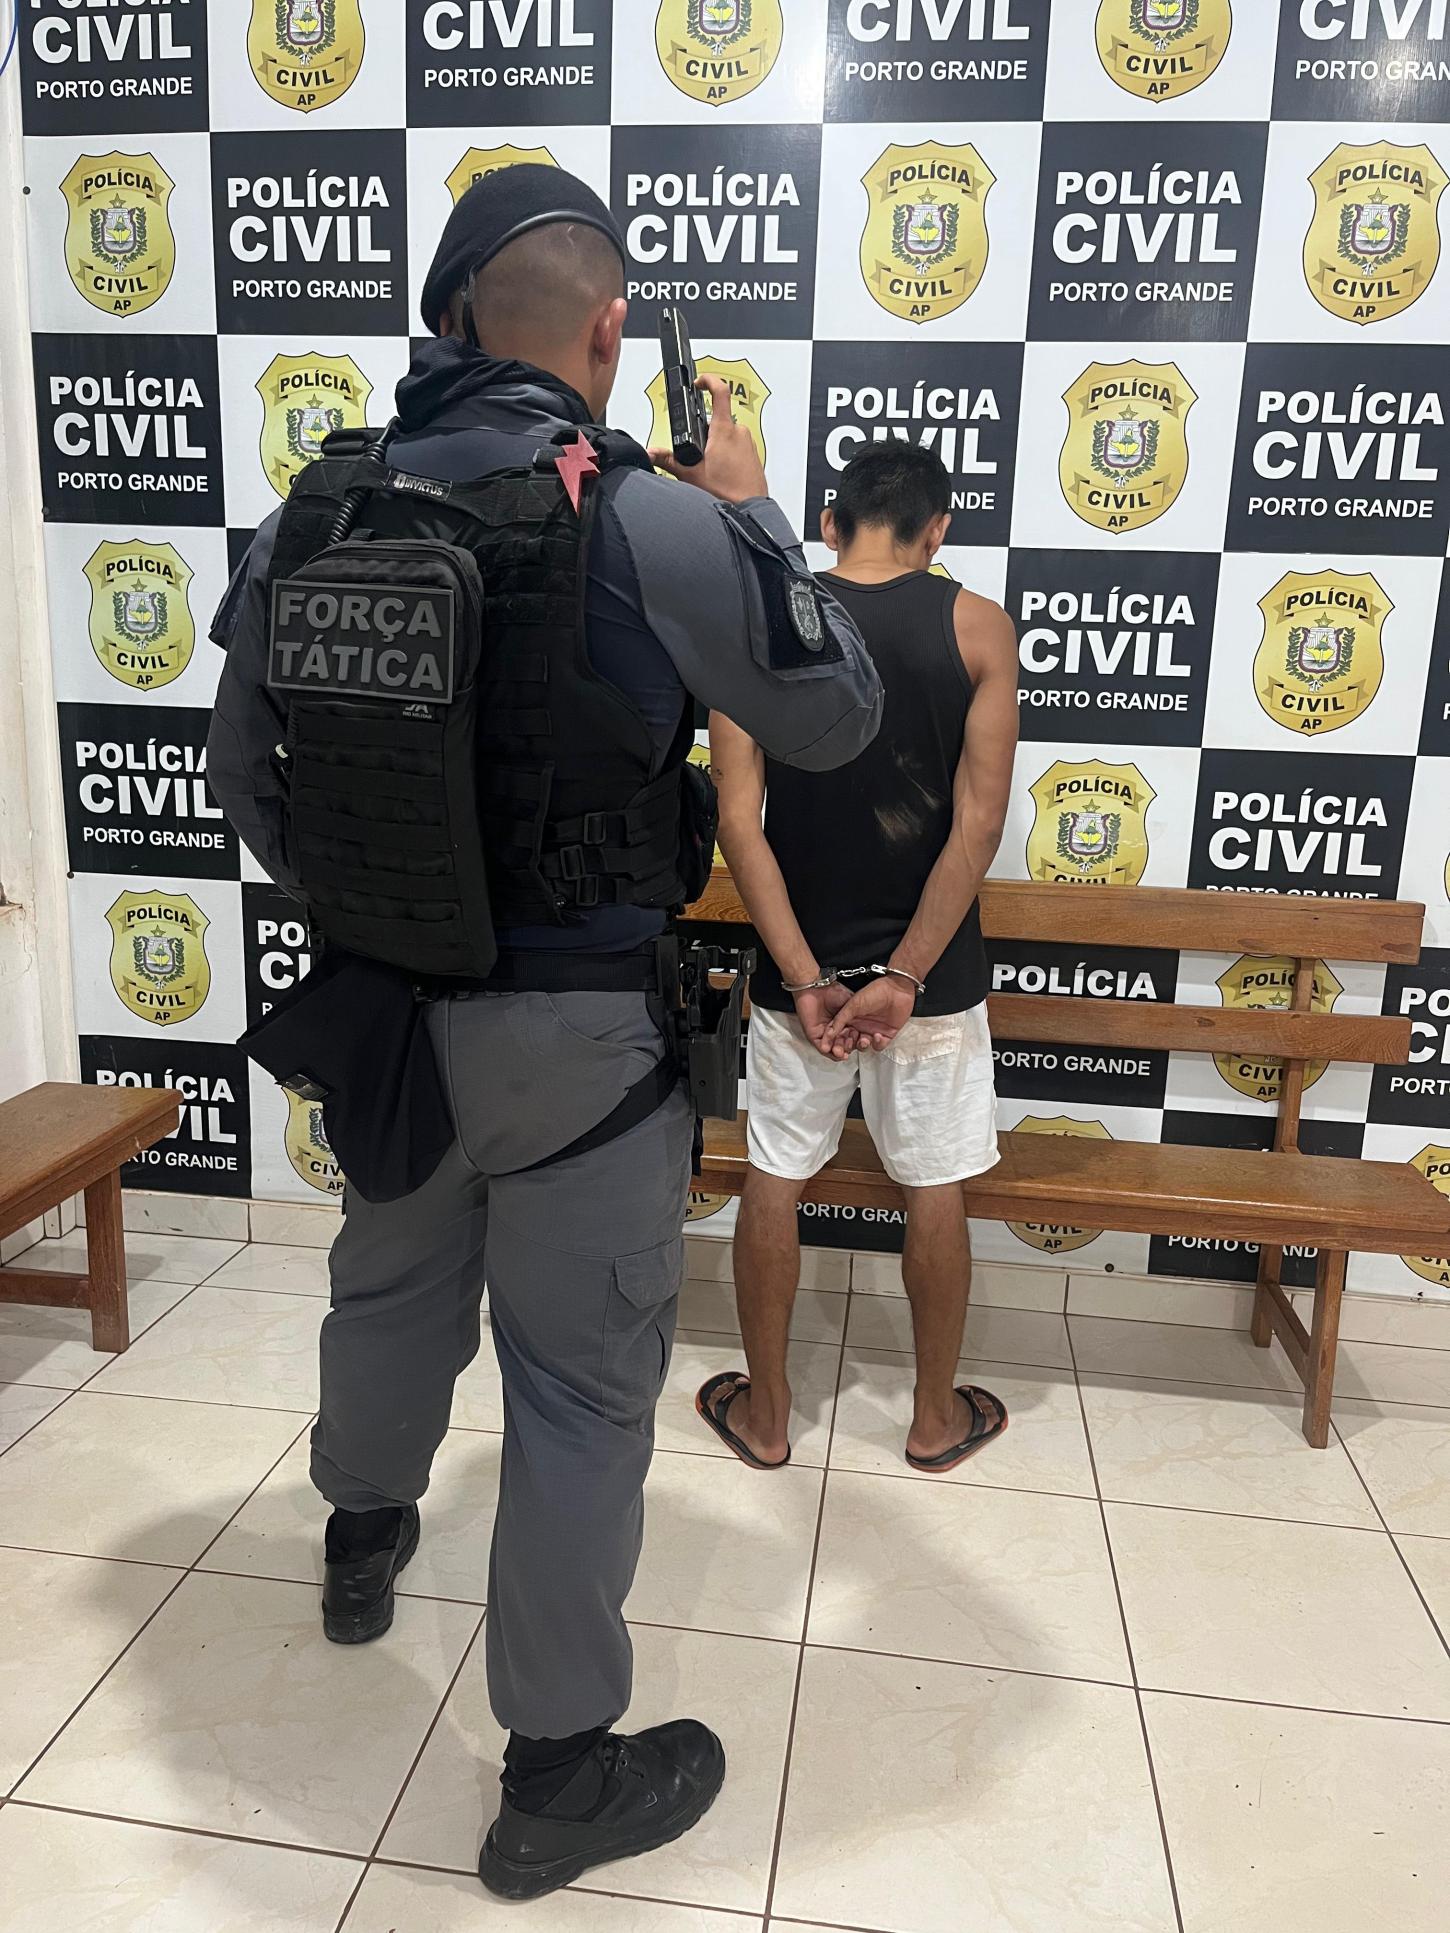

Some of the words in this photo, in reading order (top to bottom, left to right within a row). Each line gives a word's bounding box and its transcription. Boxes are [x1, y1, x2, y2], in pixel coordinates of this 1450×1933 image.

[423, 0, 593, 50] CIVIL
[847, 0, 1029, 42] CIVIL
[1299, 0, 1450, 40] CIVI
[33, 13, 191, 63] CIVIL
[686, 60, 748, 78] CIVIL
[845, 61, 924, 81] PORTO
[931, 61, 1027, 80] GRANDE
[1127, 56, 1193, 74] CIVIL
[1295, 60, 1379, 80] PORTO
[1385, 61, 1450, 81] GRAN
[277, 70, 334, 87] CIVIL
[425, 68, 497, 87] PORTO
[504, 66, 593, 86] GRANDE
[37, 80, 104, 98] PORTO
[110, 77, 192, 96] GRANDE
[707, 87, 727, 98] AP
[1147, 83, 1169, 94] AP
[297, 94, 315, 105] AP
[83, 168, 154, 193] POLÍCIA
[890, 160, 970, 186] POLÍCIA
[1339, 160, 1423, 187] POLÍCIA
[228, 169, 389, 208] POLÍCIA
[628, 166, 800, 206] POLÍCIA
[1056, 163, 1241, 204] POLÍCIA
[230, 216, 390, 262] CIVIL
[627, 215, 798, 263] CIVIL
[1053, 213, 1236, 263] CIVIL
[94, 276, 148, 293] CIVIL
[233, 280, 301, 297] PORTO
[307, 280, 392, 298] GRANDE
[628, 282, 699, 300] PORTO
[707, 282, 797, 300] GRANDE
[890, 279, 952, 297] CIVIL
[1050, 283, 1128, 301] PORTO
[1135, 283, 1233, 301] GRANDE
[1333, 279, 1400, 298] CIVIL
[114, 300, 131, 310] AP
[910, 305, 930, 316] AP
[1353, 306, 1375, 317] AP
[50, 371, 204, 407] POLÍCIA
[281, 373, 351, 393] POLÍCIA
[1091, 382, 1171, 404] POLÍCIA
[827, 381, 1000, 419] POLÍCIA
[1258, 384, 1444, 424] POLÍCIA
[54, 413, 206, 458] CIVIL
[1253, 431, 1438, 480] CIVIL
[58, 472, 122, 489] PORTO
[128, 474, 208, 492] GRANDE
[1088, 491, 1150, 508] CIVIL
[1248, 497, 1327, 516] PORTO
[1335, 499, 1433, 517] GRANDE
[1107, 516, 1128, 526] AP
[107, 556, 173, 578] POLÍCIA
[1022, 587, 1195, 625] POLÍCIA
[1287, 591, 1368, 612] POLÍCIA
[278, 593, 442, 642] FORÇA
[117, 653, 169, 669] CIVIL
[1019, 629, 1191, 676] CIVIL
[276, 636, 444, 691] TÁTICA
[137, 675, 153, 684] AP
[1017, 689, 1090, 707] PORTO
[1097, 692, 1188, 711] GRANDE
[1282, 694, 1344, 712] CIVIL
[1301, 719, 1322, 729] AP
[80, 774, 223, 818] CIVIL
[1056, 779, 1132, 800] POLÍCIA
[1213, 788, 1387, 826] POLÍCIA
[84, 827, 144, 844] PORTO
[150, 831, 225, 848] GRANDE
[1209, 827, 1381, 876] CIVIL
[127, 907, 190, 926] POLÍCIA
[993, 963, 1157, 999] POLÍCIA
[137, 991, 185, 1006] CIVIL
[155, 1012, 170, 1020] AP
[1064, 1056, 1150, 1075] GRANDE
[1239, 1063, 1283, 1080] CIVI
[1257, 1087, 1276, 1096] AP
[1391, 1077, 1450, 1095] PORT
[166, 1152, 237, 1170] GRANDE
[310, 1161, 340, 1176] CIV
[328, 1181, 343, 1190] AP
[862, 1208, 907, 1224] GRA
[1044, 1239, 1062, 1248] AP
